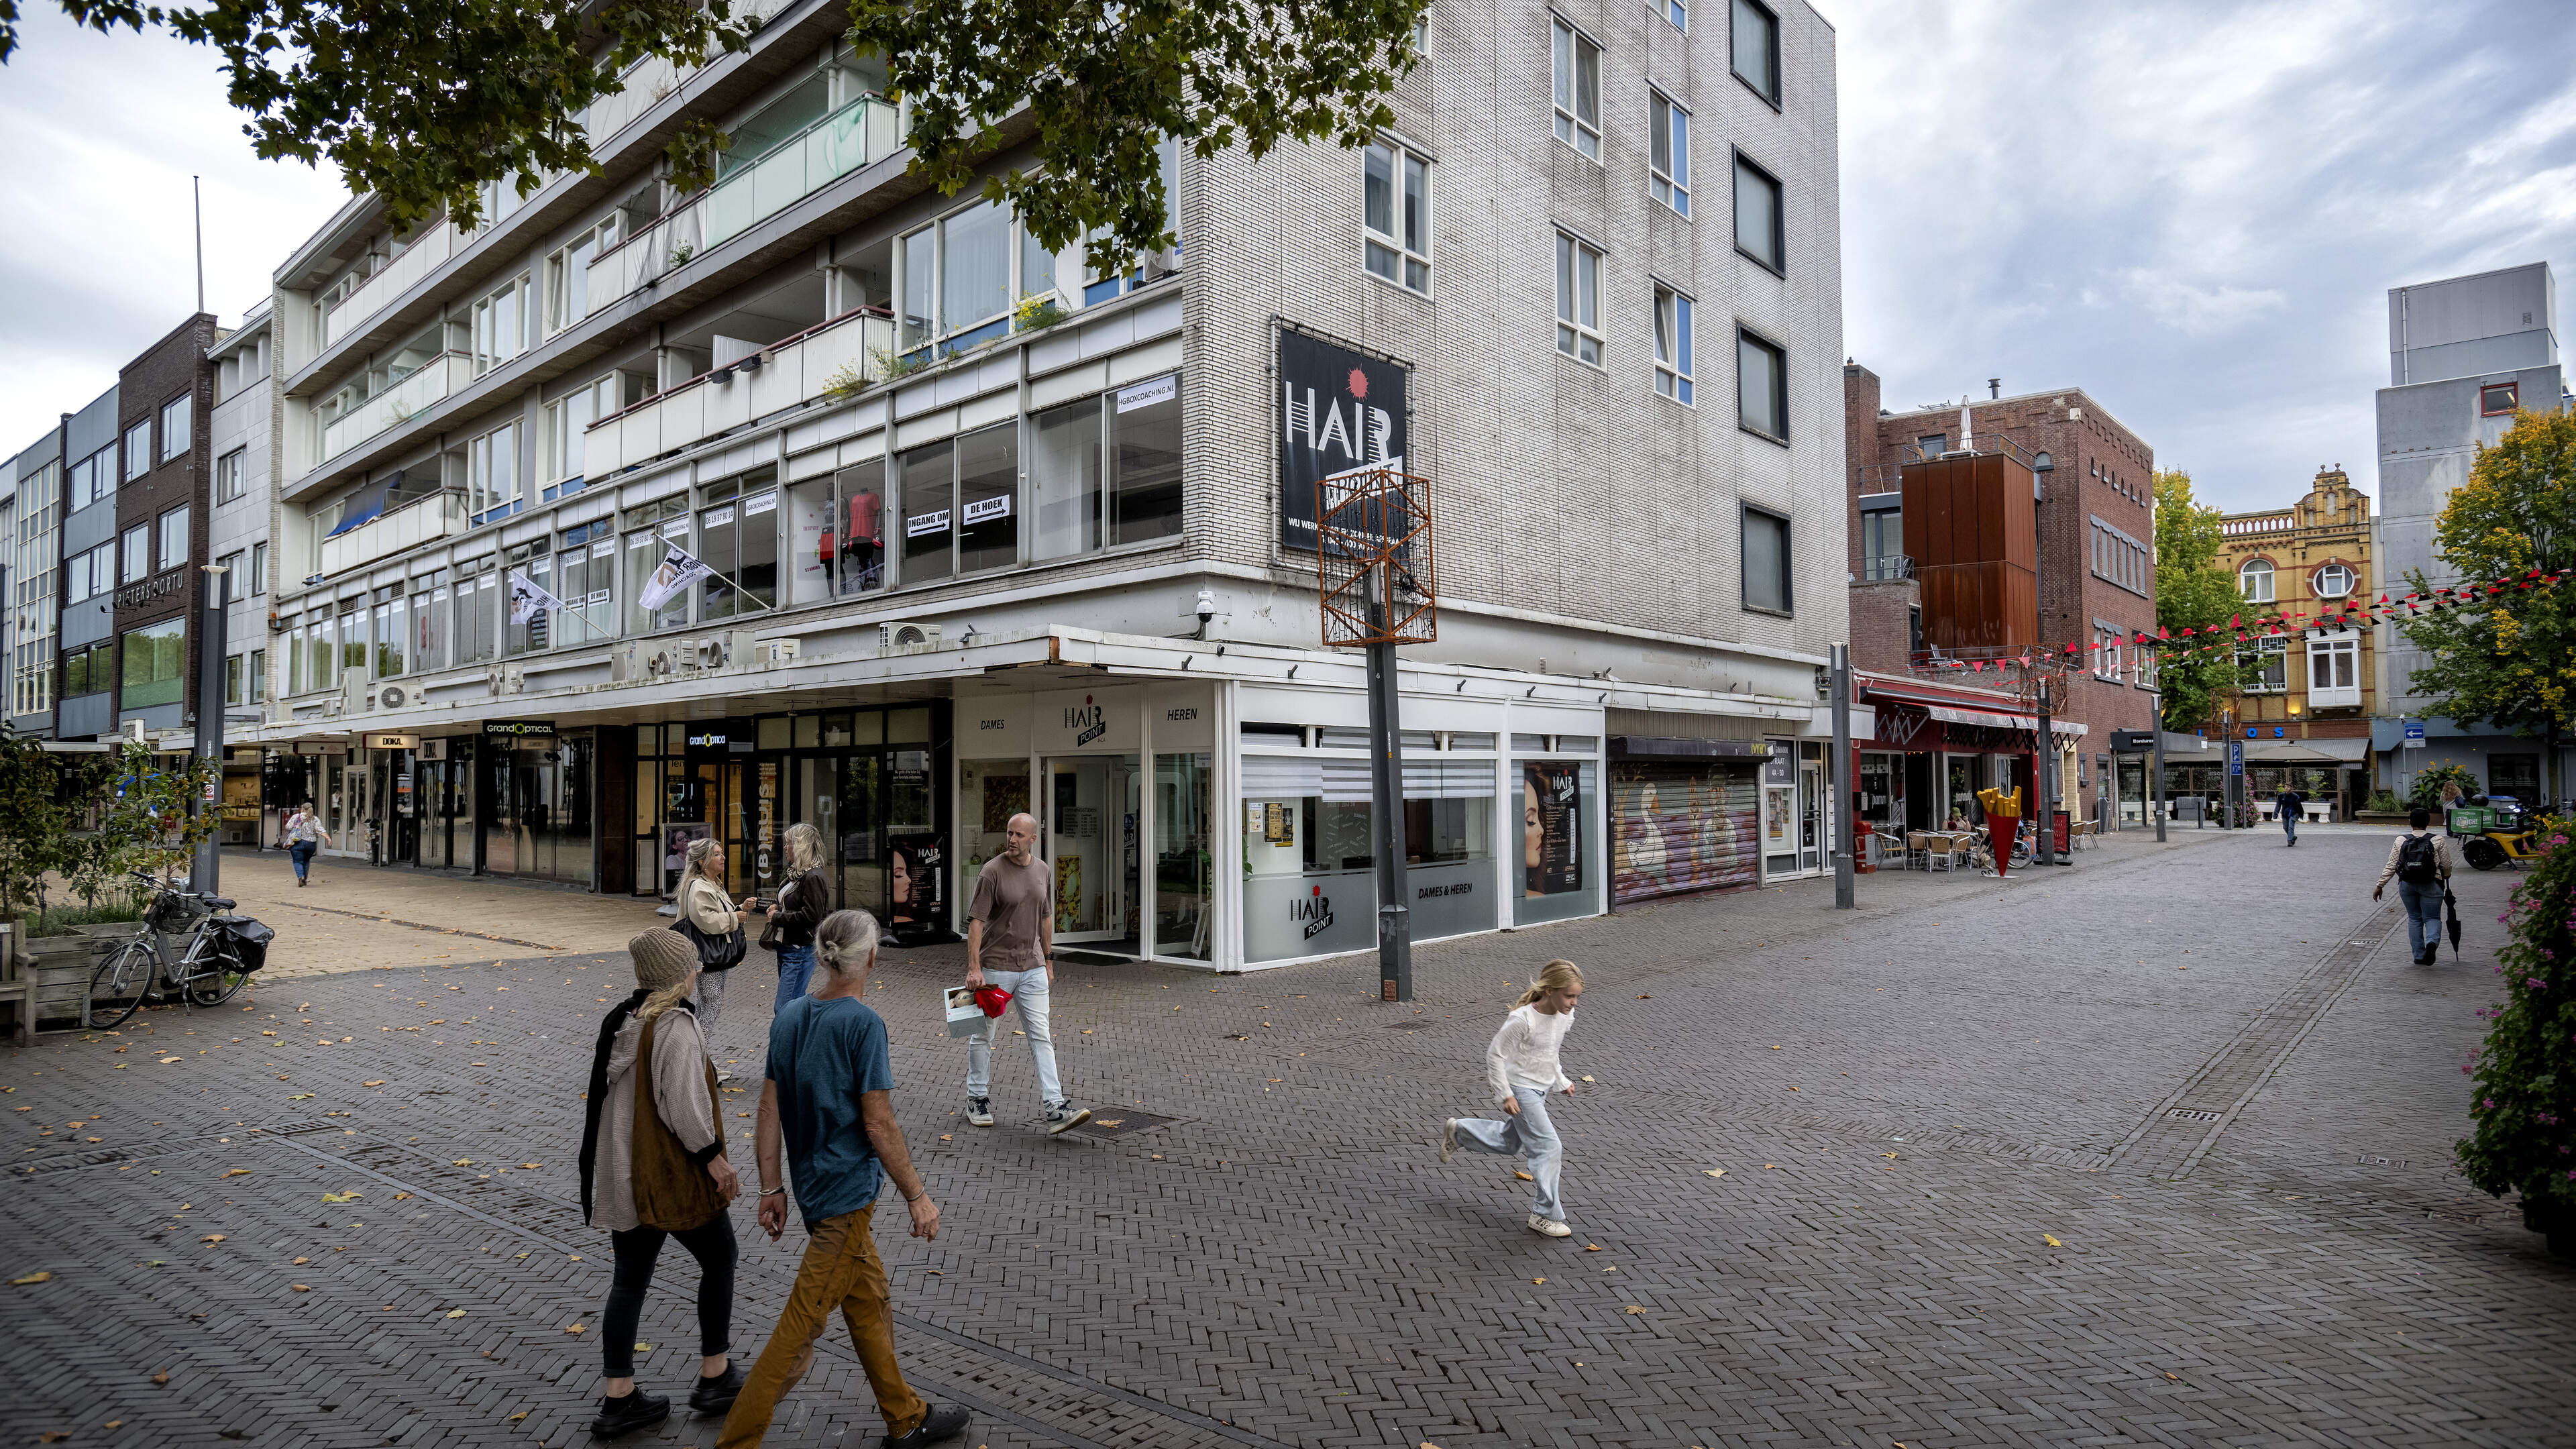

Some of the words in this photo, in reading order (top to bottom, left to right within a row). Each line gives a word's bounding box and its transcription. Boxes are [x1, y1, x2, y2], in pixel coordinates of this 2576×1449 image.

[1118, 384, 1175, 406] HGBOXCOACHING.NL
[1285, 381, 1392, 464] HAIR
[1338, 463, 1394, 502] POINT
[970, 505, 980, 514] DE
[982, 498, 1003, 511] HOEK
[706, 516, 711, 525] 06
[712, 515, 716, 523] 19
[717, 513, 722, 521] 37
[722, 512, 728, 520] 80
[729, 510, 733, 519] 14
[908, 515, 936, 528] INGANG
[937, 511, 949, 522] OM
[1288, 517, 1300, 527] WIJ
[1301, 519, 1326, 532] WERK
[1064, 706, 1102, 729] HAIR
[1167, 708, 1197, 721] HEREN
[980, 719, 1005, 731] DAMES
[382, 737, 403, 745] DOKA.
[1081, 724, 1102, 744] POINT
[2233, 745, 2239, 754] P
[1553, 775, 1572, 790] HAIR
[918, 849, 939, 857] HAIR
[1418, 886, 1443, 900] DAMES
[1444, 885, 1450, 896] &
[1450, 883, 1472, 895] HEREN
[1291, 896, 1330, 922] HAIR
[1308, 914, 1331, 936] POINT
